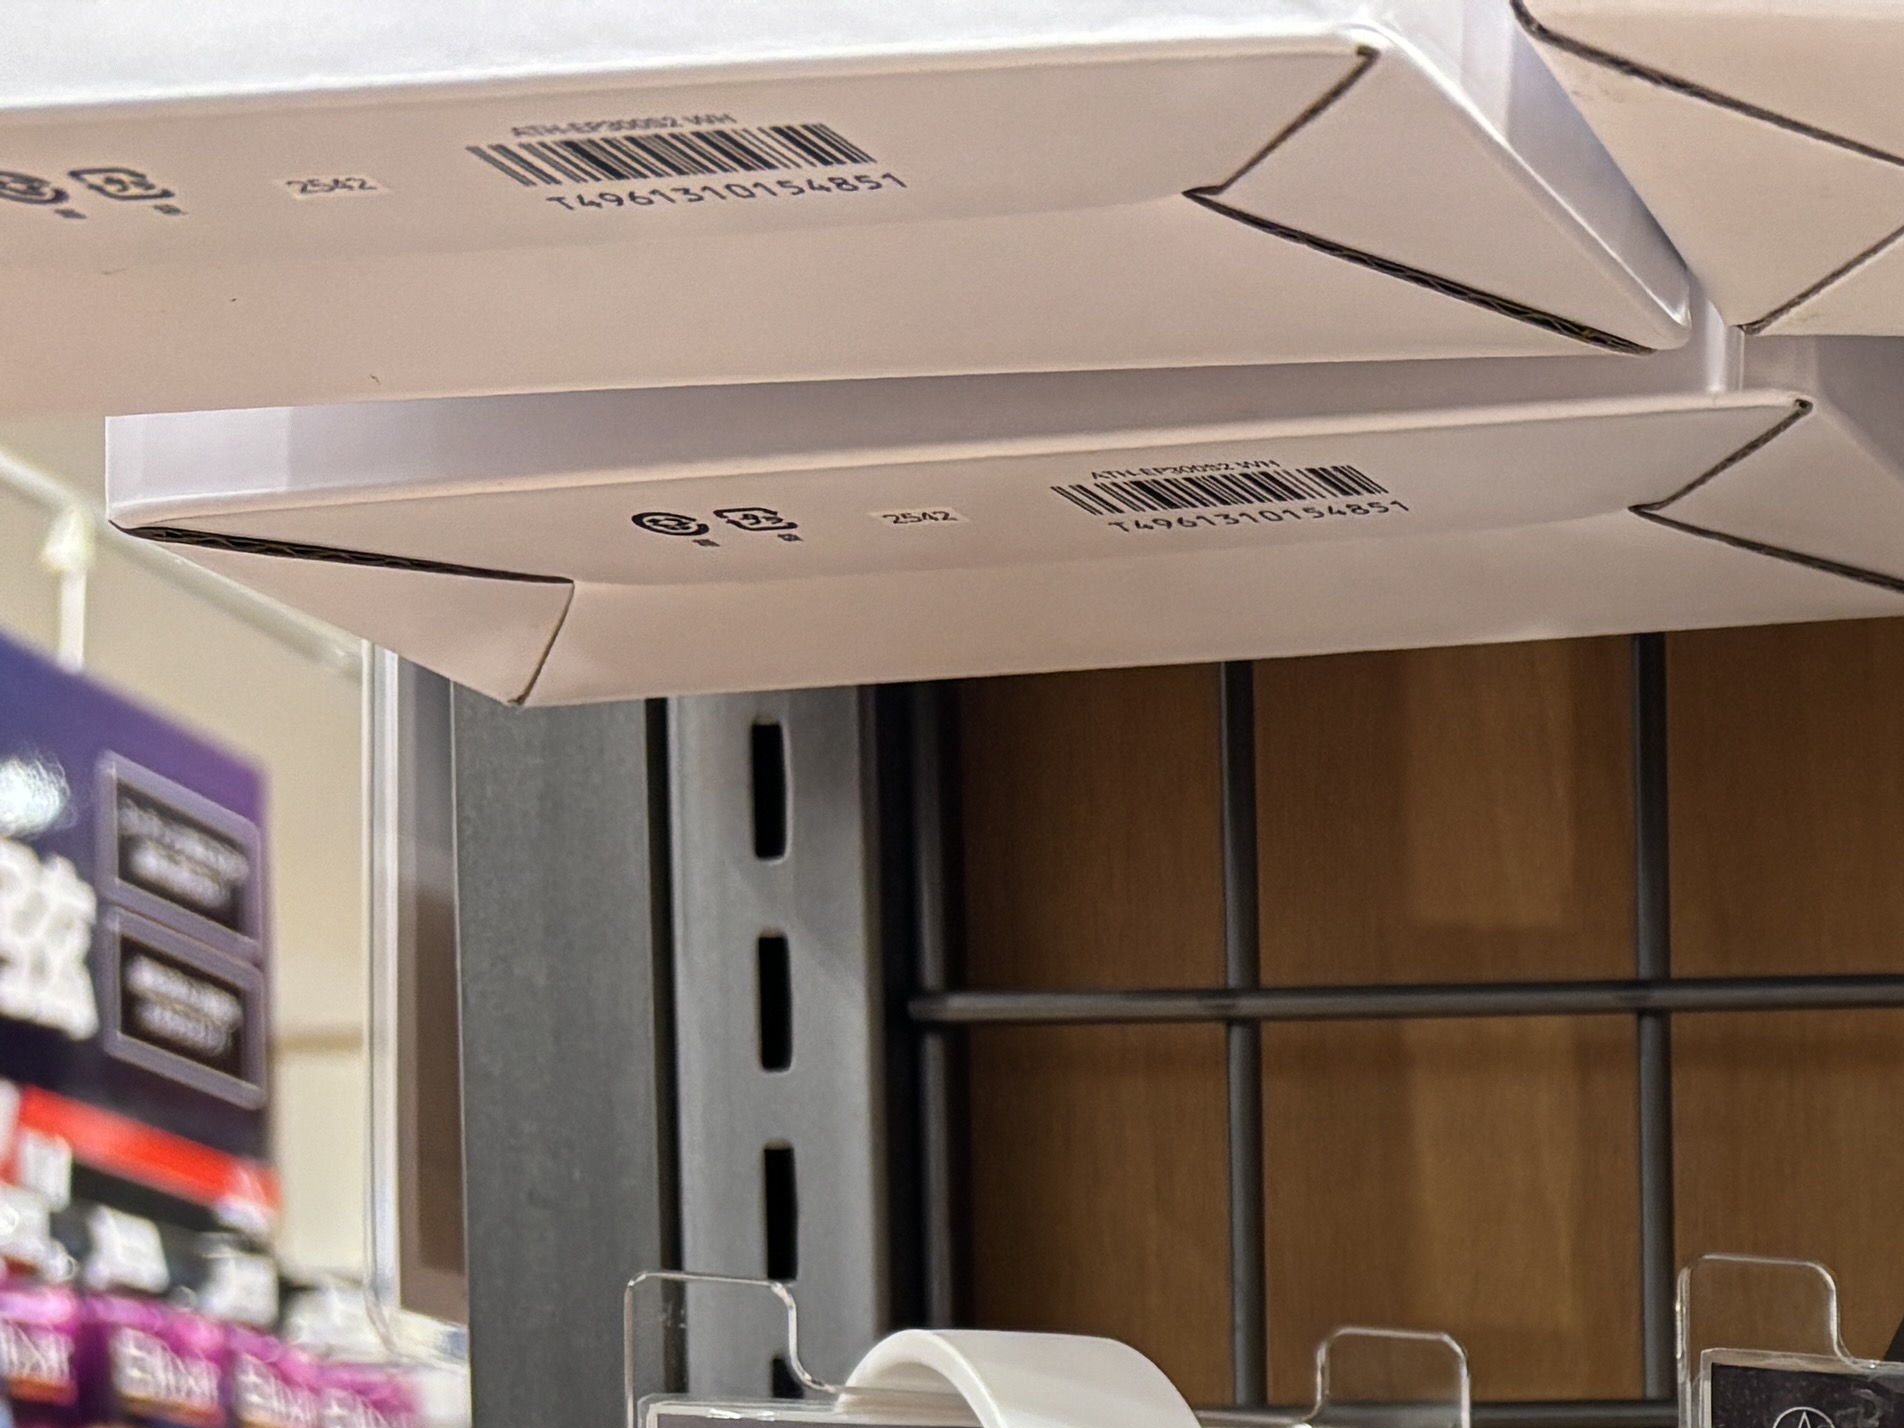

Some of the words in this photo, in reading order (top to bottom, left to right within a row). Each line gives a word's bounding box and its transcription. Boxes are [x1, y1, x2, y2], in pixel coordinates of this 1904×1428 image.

[546, 171, 909, 212] T4961310154851
[881, 510, 958, 526] 2542
[1108, 499, 1411, 534] T4961310154851
